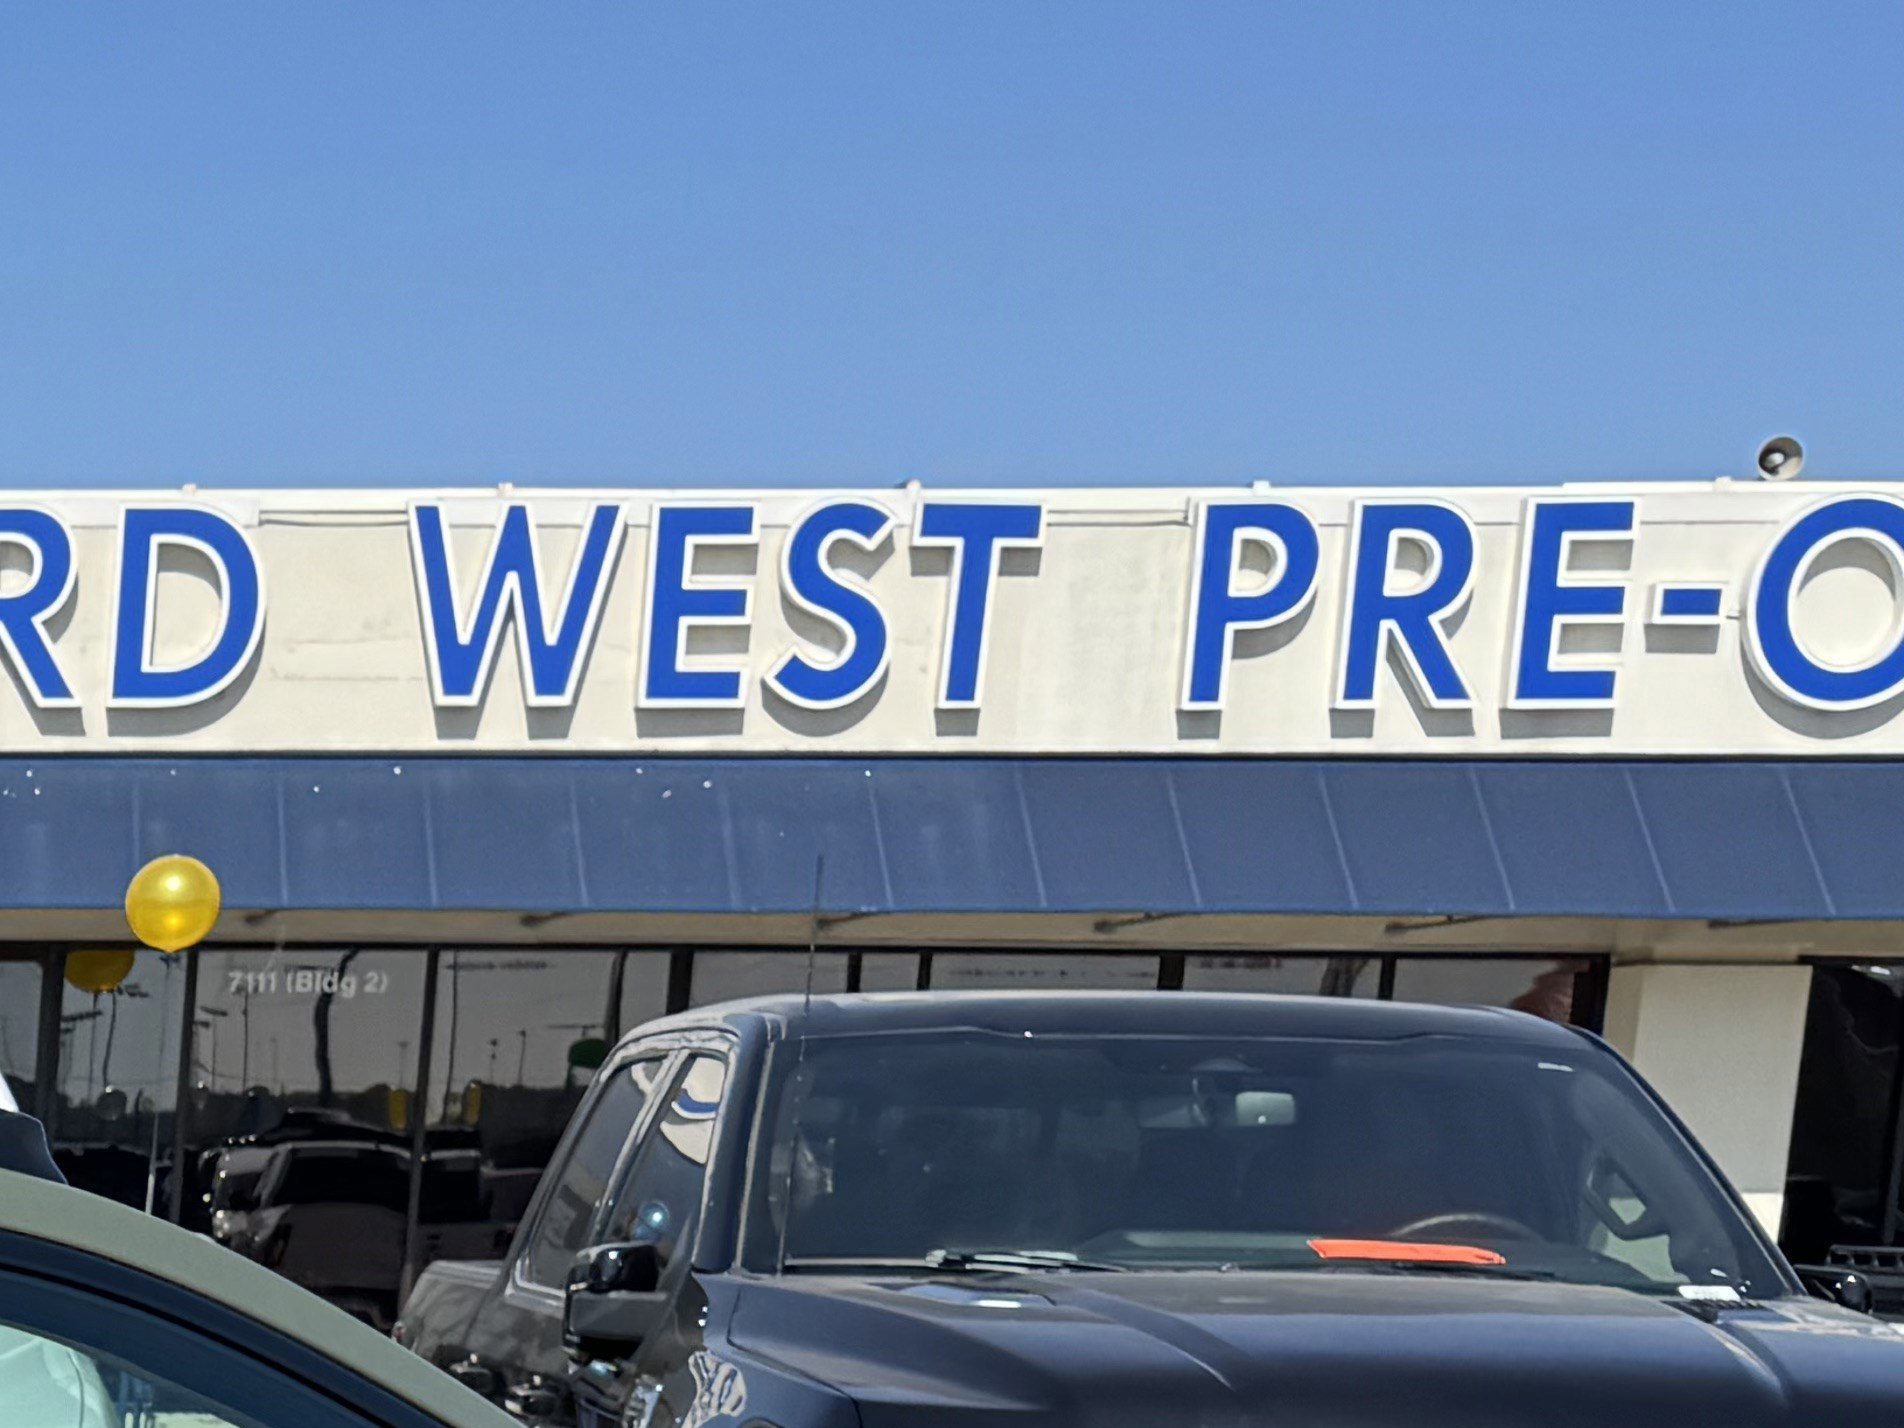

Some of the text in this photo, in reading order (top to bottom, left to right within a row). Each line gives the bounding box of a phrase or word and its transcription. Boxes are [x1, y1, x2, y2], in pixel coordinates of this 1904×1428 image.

[409, 496, 1046, 713] WEST
[1176, 492, 1904, 713] PRE-O
[228, 969, 389, 998] 7111 (Bldg 2)
